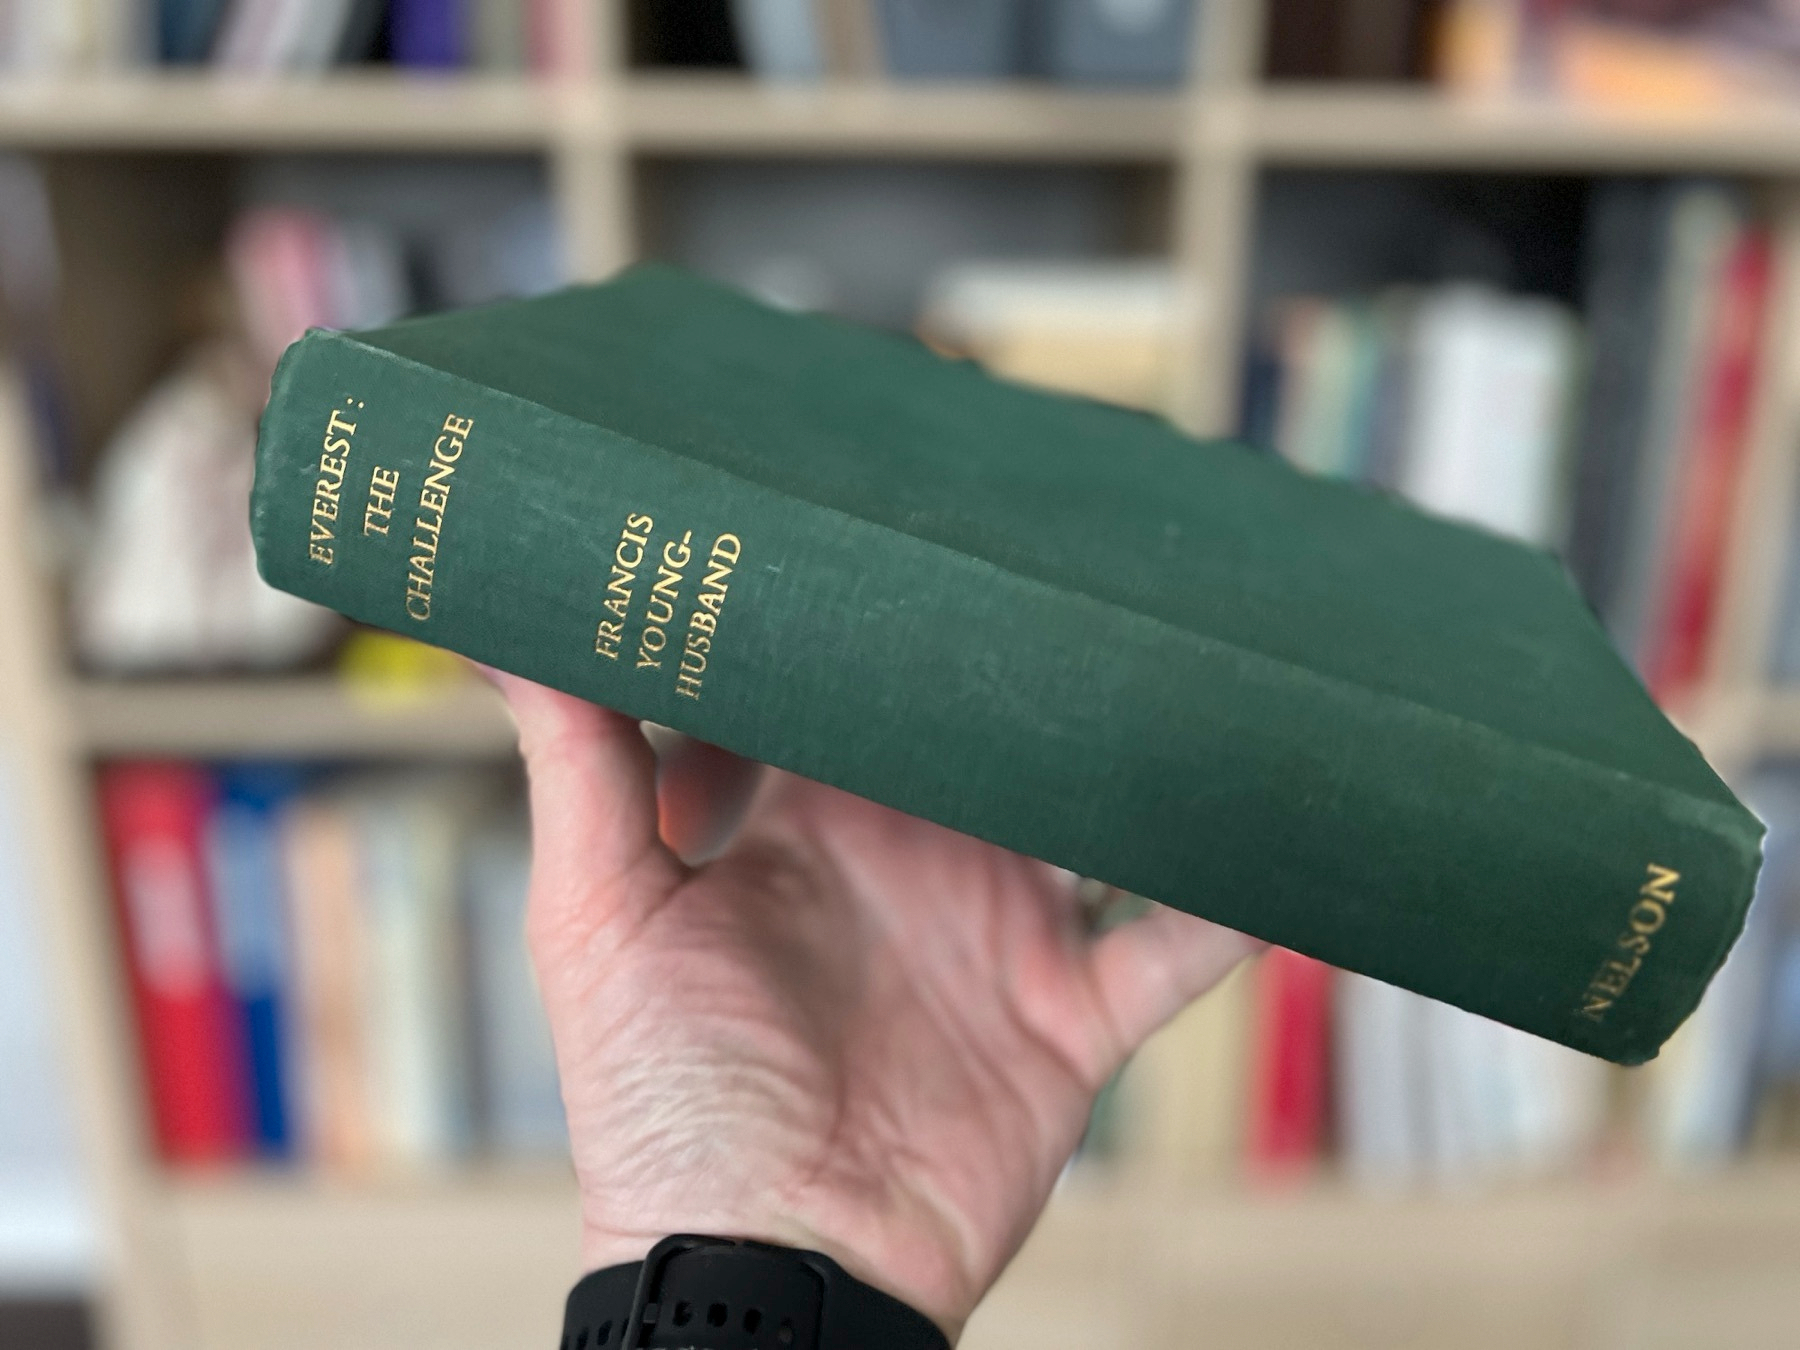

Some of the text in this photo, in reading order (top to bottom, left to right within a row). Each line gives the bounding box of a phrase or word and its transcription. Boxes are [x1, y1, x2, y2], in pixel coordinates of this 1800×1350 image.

[363, 465, 400, 536] THE
[406, 413, 474, 621] CHALLENGE
[596, 512, 654, 661] FRANCIS
[636, 530, 692, 670] YOUNG-
[675, 532, 741, 700] HUSBAND
[1582, 862, 1681, 1023] NELSON
